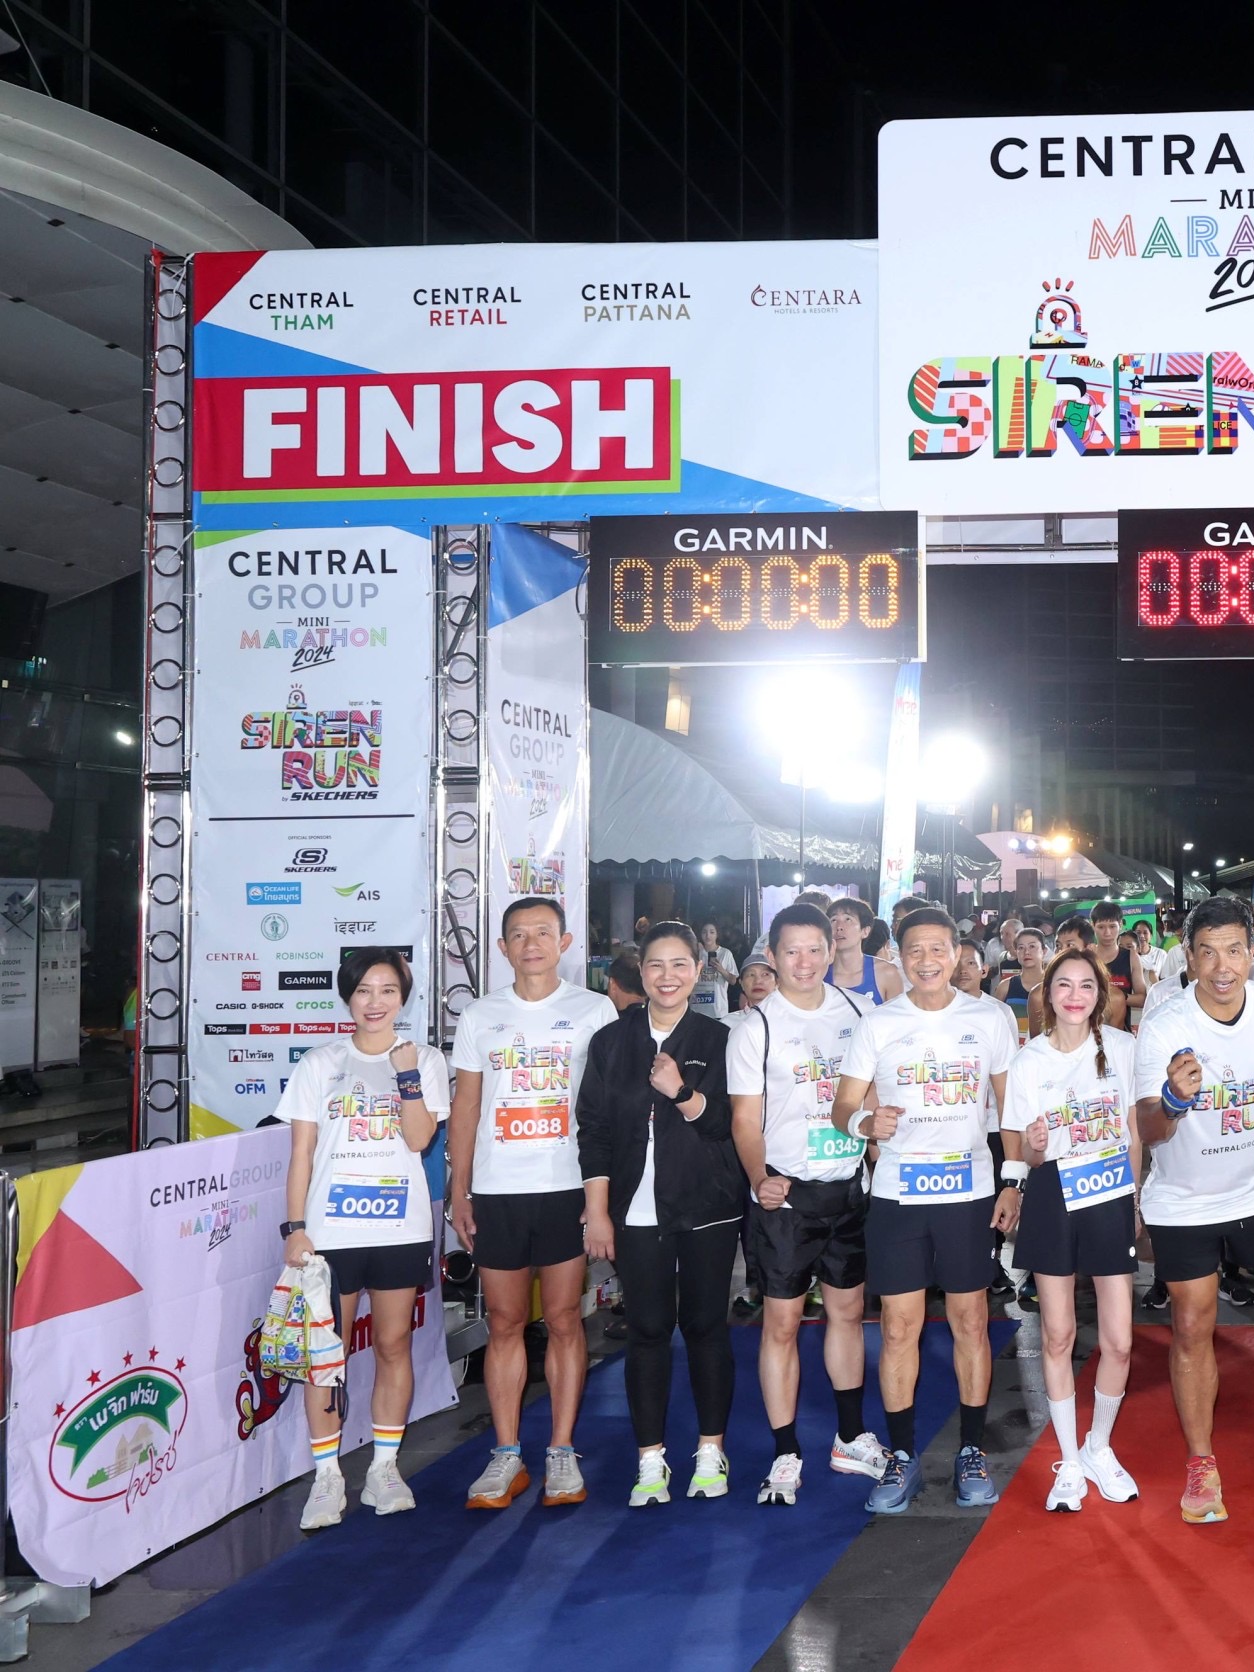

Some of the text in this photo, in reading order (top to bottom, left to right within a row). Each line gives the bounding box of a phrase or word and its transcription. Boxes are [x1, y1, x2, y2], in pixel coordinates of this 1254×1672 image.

[248, 291, 354, 311] CENTRAL
[412, 286, 522, 307] CENTRAL
[581, 282, 691, 301] CENTRAL
[751, 284, 862, 307] CENTARA
[270, 314, 335, 331] THAM
[428, 307, 508, 327] RETAIL
[583, 304, 691, 323] PATTANA
[243, 378, 654, 478] FINISH
[673, 526, 828, 552] GARMIN
[228, 549, 398, 577] CENTRAL
[247, 582, 379, 610] GROUP
[297, 617, 330, 627] MINI
[240, 627, 387, 650] MARATHON
[292, 646, 334, 668] 2024
[501, 699, 572, 738] CENTRAL
[241, 709, 382, 750] SIREN
[510, 734, 565, 765] GROUP
[282, 749, 381, 791] RUN
[290, 790, 379, 801] SKECHERS
[264, 892, 300, 903] ไทยสมุทร
[357, 890, 380, 901] AIS
[206, 952, 259, 961] CENTRAL
[276, 952, 324, 960] ROBINSON
[242, 973, 260, 981] cmg
[284, 976, 327, 985] GARMIN
[251, 1002, 284, 1010] G-SHOCK
[296, 1001, 334, 1009] crocs
[207, 1025, 228, 1034] Tops
[260, 1024, 280, 1033] Tops
[298, 1024, 318, 1032] Tops
[340, 1023, 357, 1031] Tops
[245, 1049, 274, 1062] ไทวัสดุ
[489, 1046, 572, 1070] SIREN
[512, 1068, 569, 1092] RUN
[897, 1060, 981, 1086] SIREN
[235, 1084, 266, 1095] OFM
[923, 1081, 979, 1107] RUN
[1045, 1094, 1120, 1131] SIREN
[510, 1118, 561, 1136] 0088
[1071, 1116, 1122, 1147] RUN
[823, 1138, 859, 1157] 0345
[916, 1174, 963, 1192] 0001
[1076, 1166, 1126, 1196] 0007
[211, 1199, 229, 1211] MINI
[342, 1197, 399, 1215] 0002
[179, 1203, 259, 1239] MARATHON
[208, 1223, 232, 1246] 2024
[89, 1395, 127, 1432] เมจิก
[130, 1381, 160, 1407] ฟาร์ม
